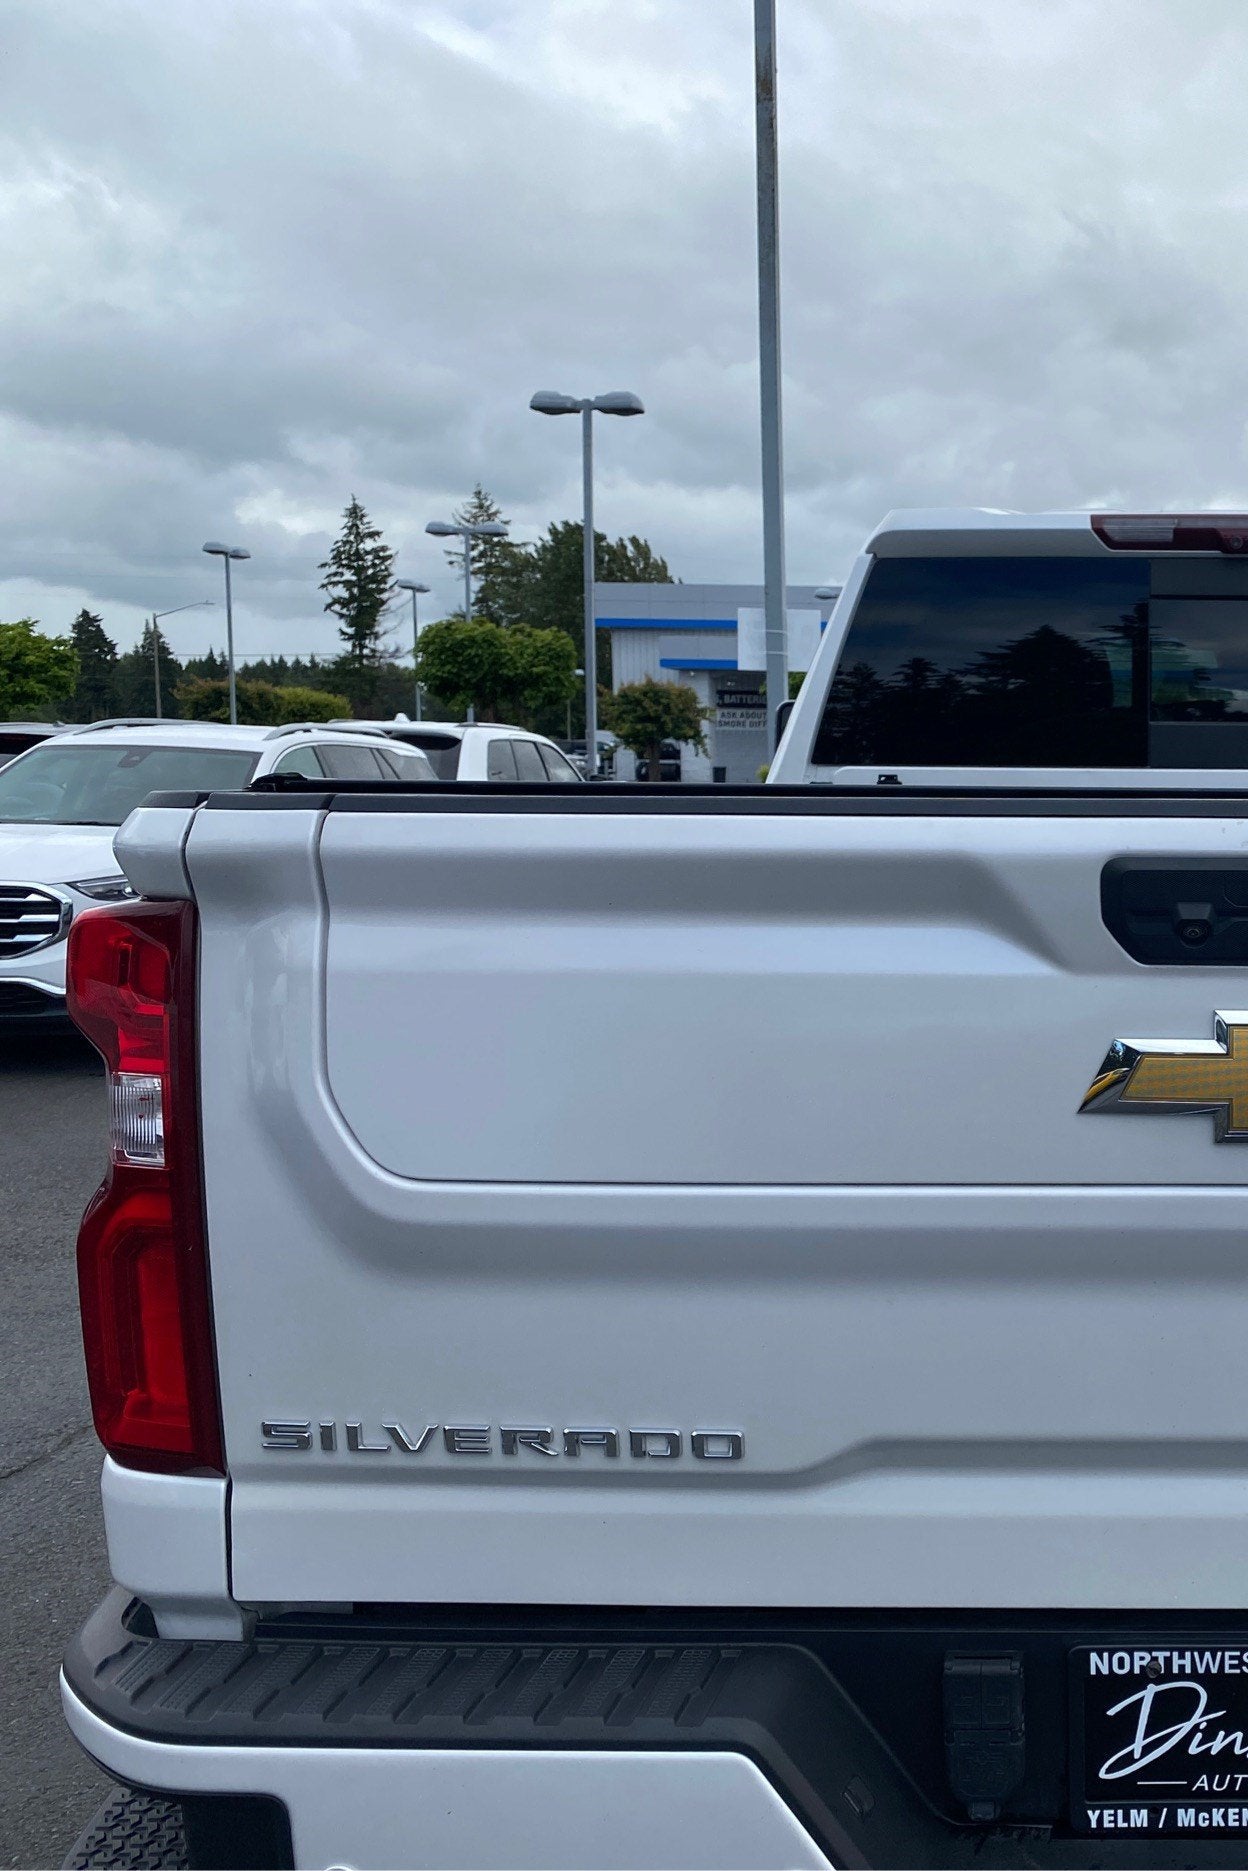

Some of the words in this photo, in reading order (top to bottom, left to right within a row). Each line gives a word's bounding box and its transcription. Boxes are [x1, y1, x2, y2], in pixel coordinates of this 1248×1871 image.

[723, 694, 767, 705] BATTERI
[718, 720, 747, 728] SMORE
[749, 720, 767, 728] DIFF
[261, 1420, 746, 1460] SILVERADO
[1087, 1808, 1148, 1828] YELM
[1158, 1807, 1168, 1828] /
